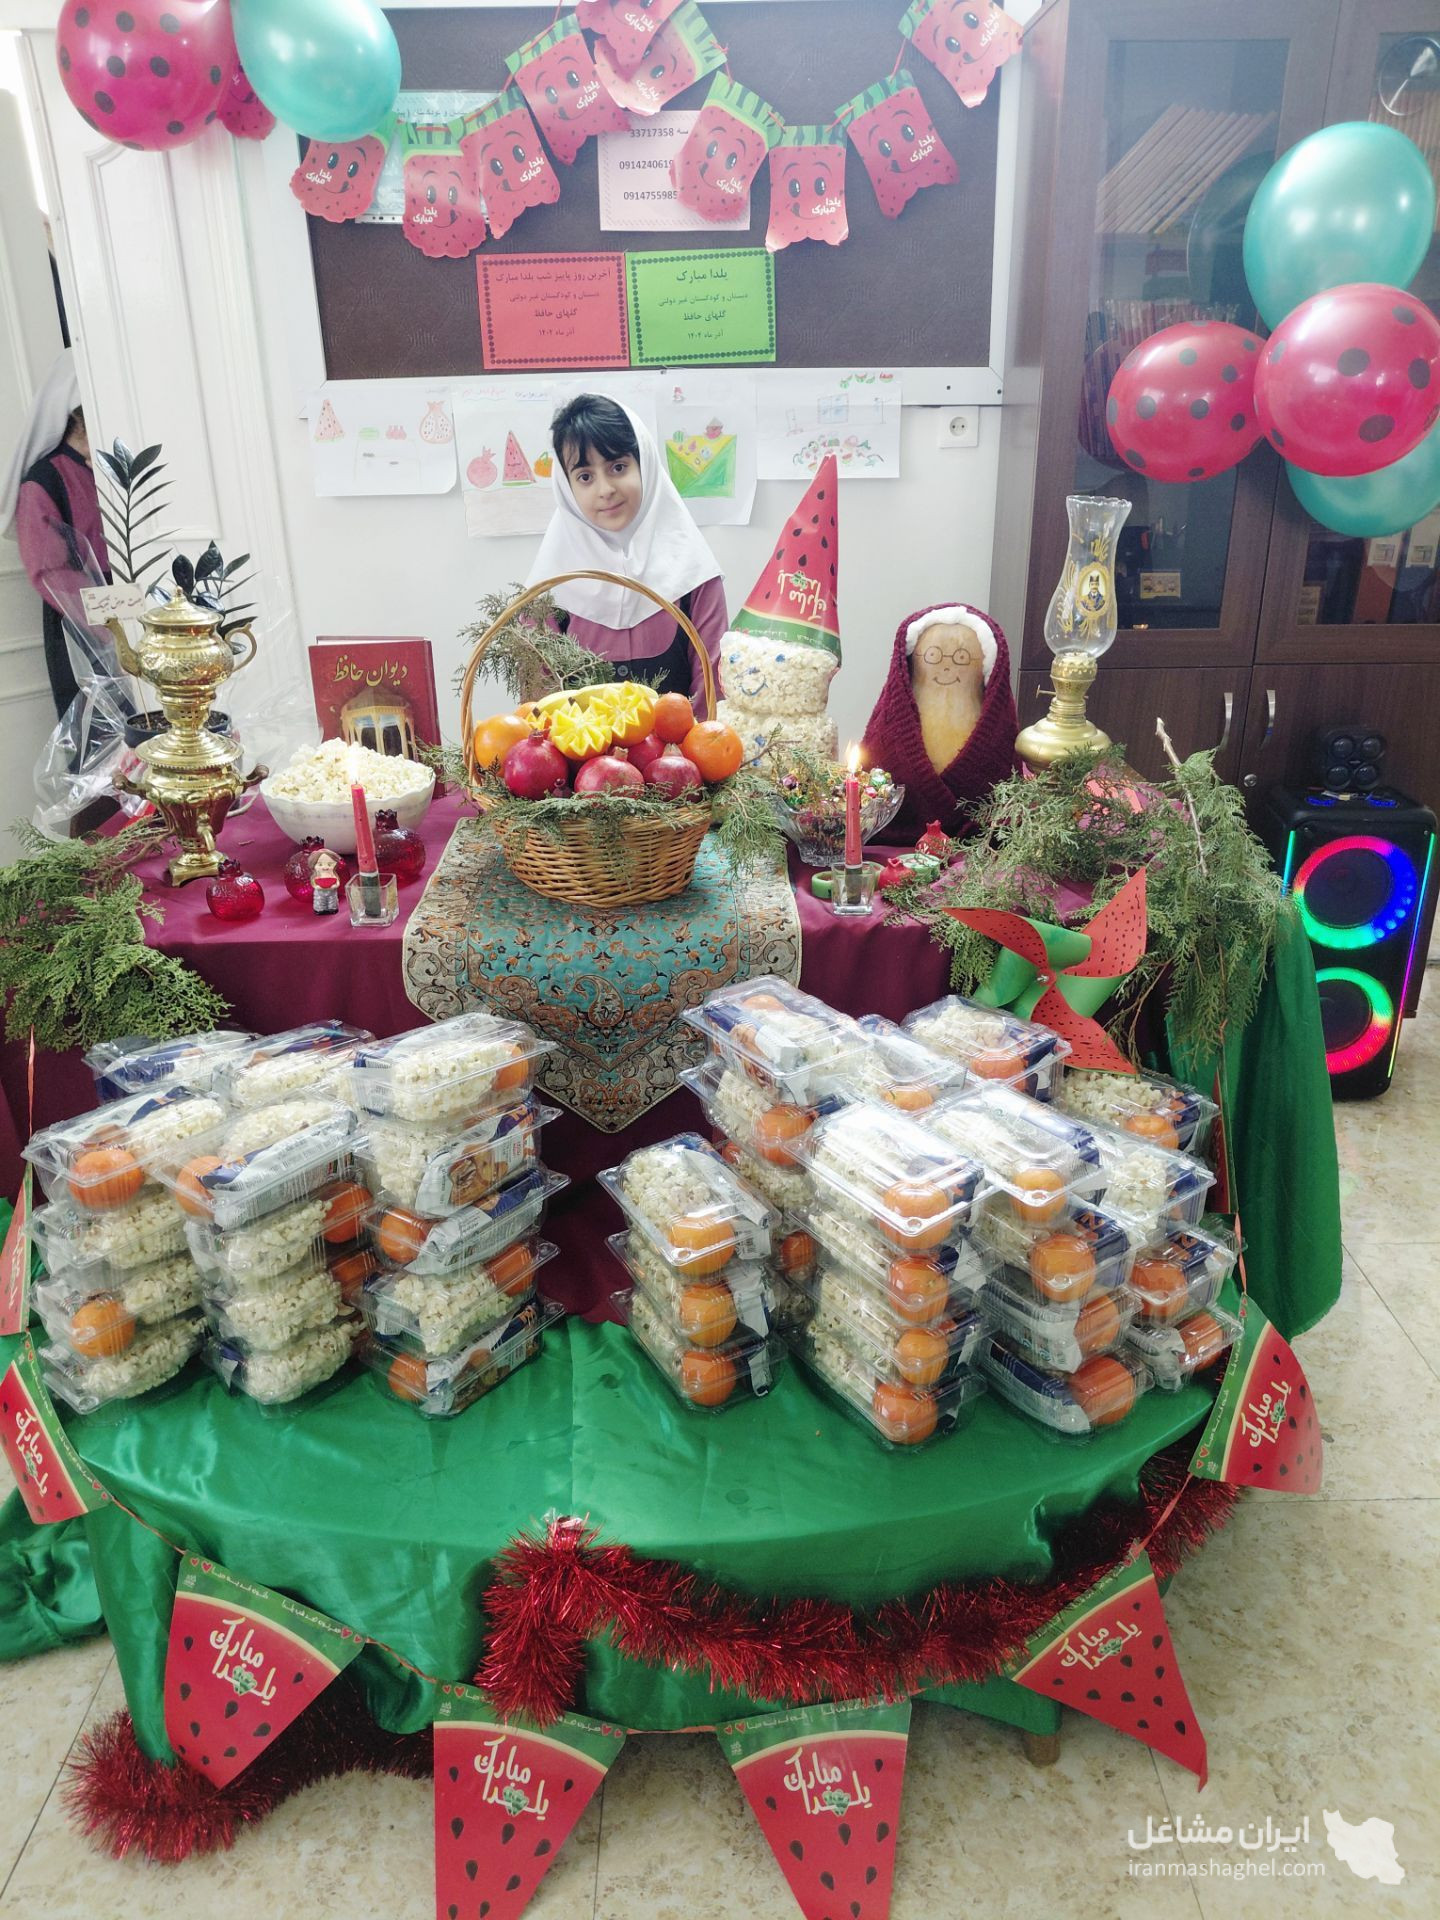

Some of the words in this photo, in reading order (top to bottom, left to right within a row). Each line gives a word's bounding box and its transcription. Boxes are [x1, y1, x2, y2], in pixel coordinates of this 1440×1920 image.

[624, 12, 646, 33] مبارک
[640, 15, 656, 32] یلدا
[984, 10, 1001, 28] یلدا
[979, 22, 999, 47] مبارک
[583, 80, 600, 93] یلدا
[576, 91, 598, 110] مبارک
[918, 134, 936, 149] یلدا
[529, 156, 545, 169] یلدا
[909, 145, 933, 164] مبارک
[619, 159, 674, 170] 0914240619
[306, 172, 326, 185] مبارک
[319, 168, 333, 182] یلدا
[519, 165, 542, 183] مبارک
[623, 190, 678, 200] 0914755985
[825, 198, 842, 208] یلدا
[424, 206, 438, 218] یلدا
[811, 204, 836, 216] مبارک
[412, 213, 433, 225] مبارک
[495, 273, 518, 285] مبارک
[676, 270, 707, 284] مبارک
[710, 267, 728, 280] یلدا
[535, 309, 554, 318] حافظ
[683, 312, 702, 321] حافظ
[705, 310, 727, 322] گلهای
[333, 655, 364, 682] حافظ
[366, 659, 408, 687] دیوان
[1240, 1393, 1272, 1448] مبارک
[209, 1616, 265, 1668] مبارک
[1056, 1627, 1109, 1667] مبارک
[1077, 1620, 1142, 1670] یلدا
[212, 1644, 277, 1706] یلدا
[473, 1734, 532, 1788] مبارک
[783, 1746, 843, 1792] مبارک
[482, 1766, 549, 1821] یلدا
[800, 1770, 873, 1815] یلدا
